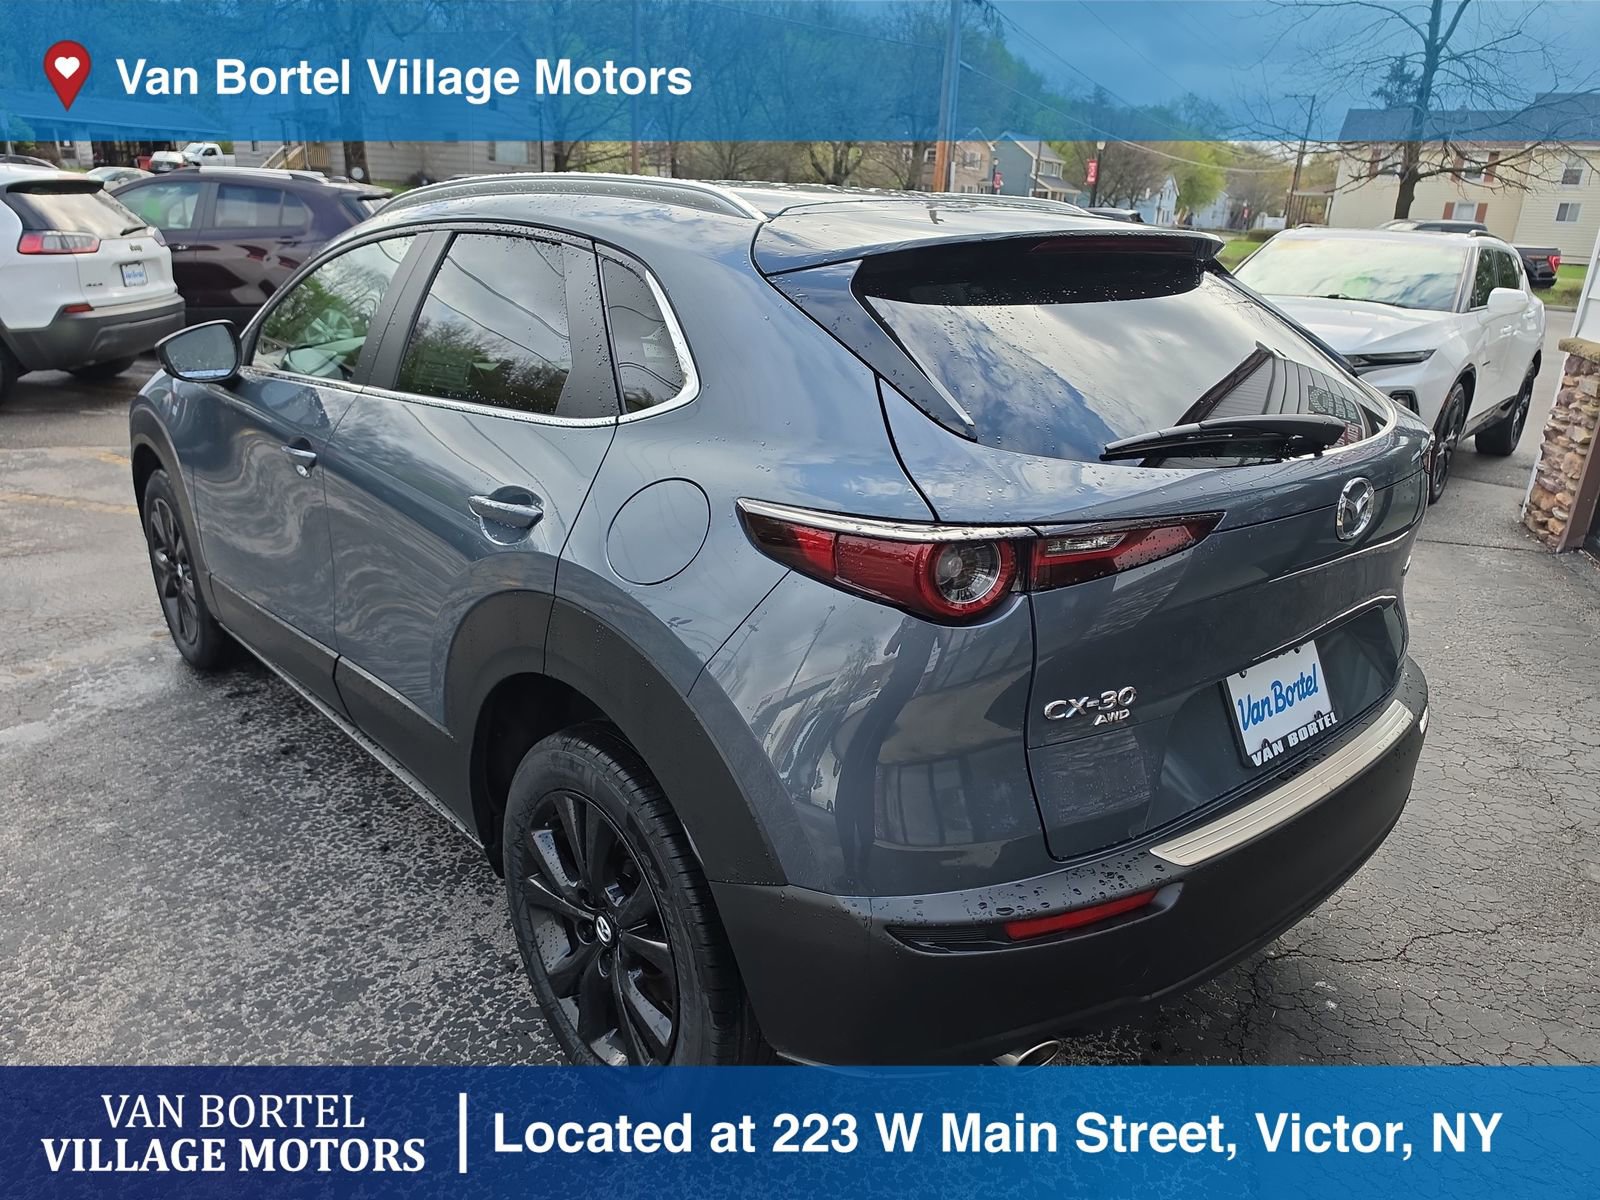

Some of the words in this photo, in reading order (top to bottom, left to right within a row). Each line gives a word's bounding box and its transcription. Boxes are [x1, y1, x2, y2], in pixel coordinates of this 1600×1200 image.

[1044, 686, 1137, 720] CX-30
[1093, 708, 1131, 726] AWD
[1238, 694, 1273, 731] Van
[1271, 663, 1318, 714] Bortel
[1251, 740, 1284, 767] VAN
[1287, 712, 1338, 748] BORTEL
